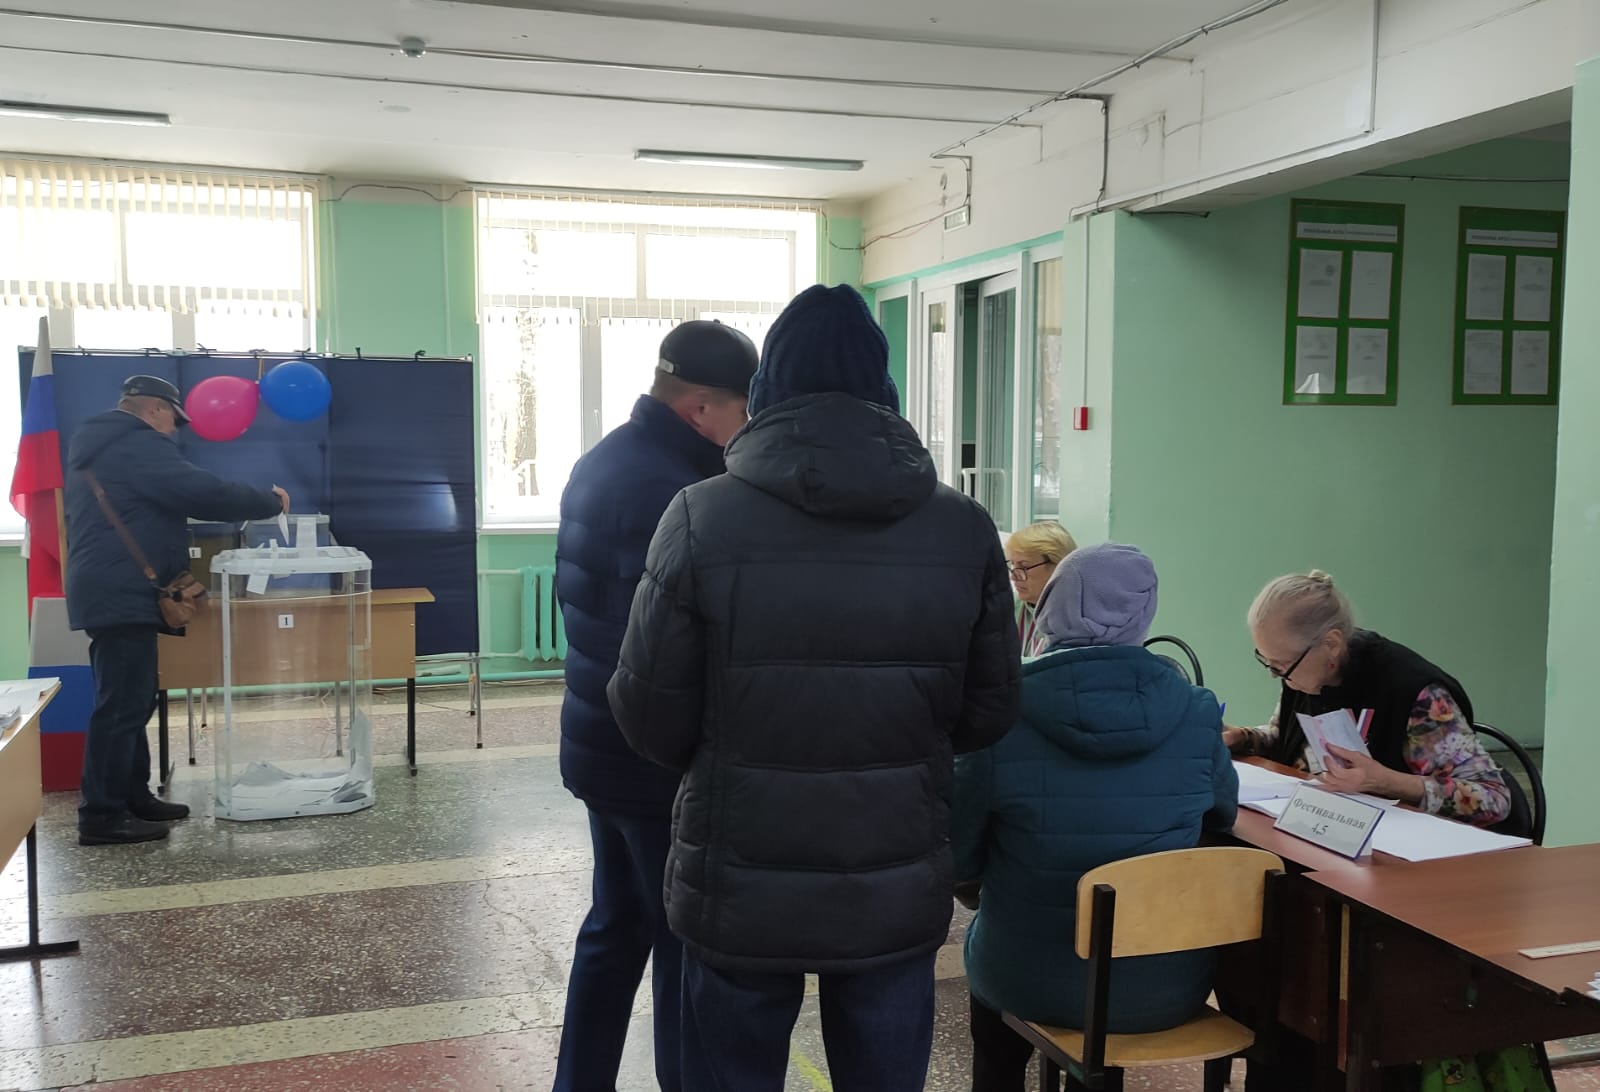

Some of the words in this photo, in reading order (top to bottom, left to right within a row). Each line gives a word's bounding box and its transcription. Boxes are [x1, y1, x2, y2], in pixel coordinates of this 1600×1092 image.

[284, 616, 289, 625] 1
[1294, 798, 1367, 829] Фестивальная
[1311, 822, 1329, 836] 45
